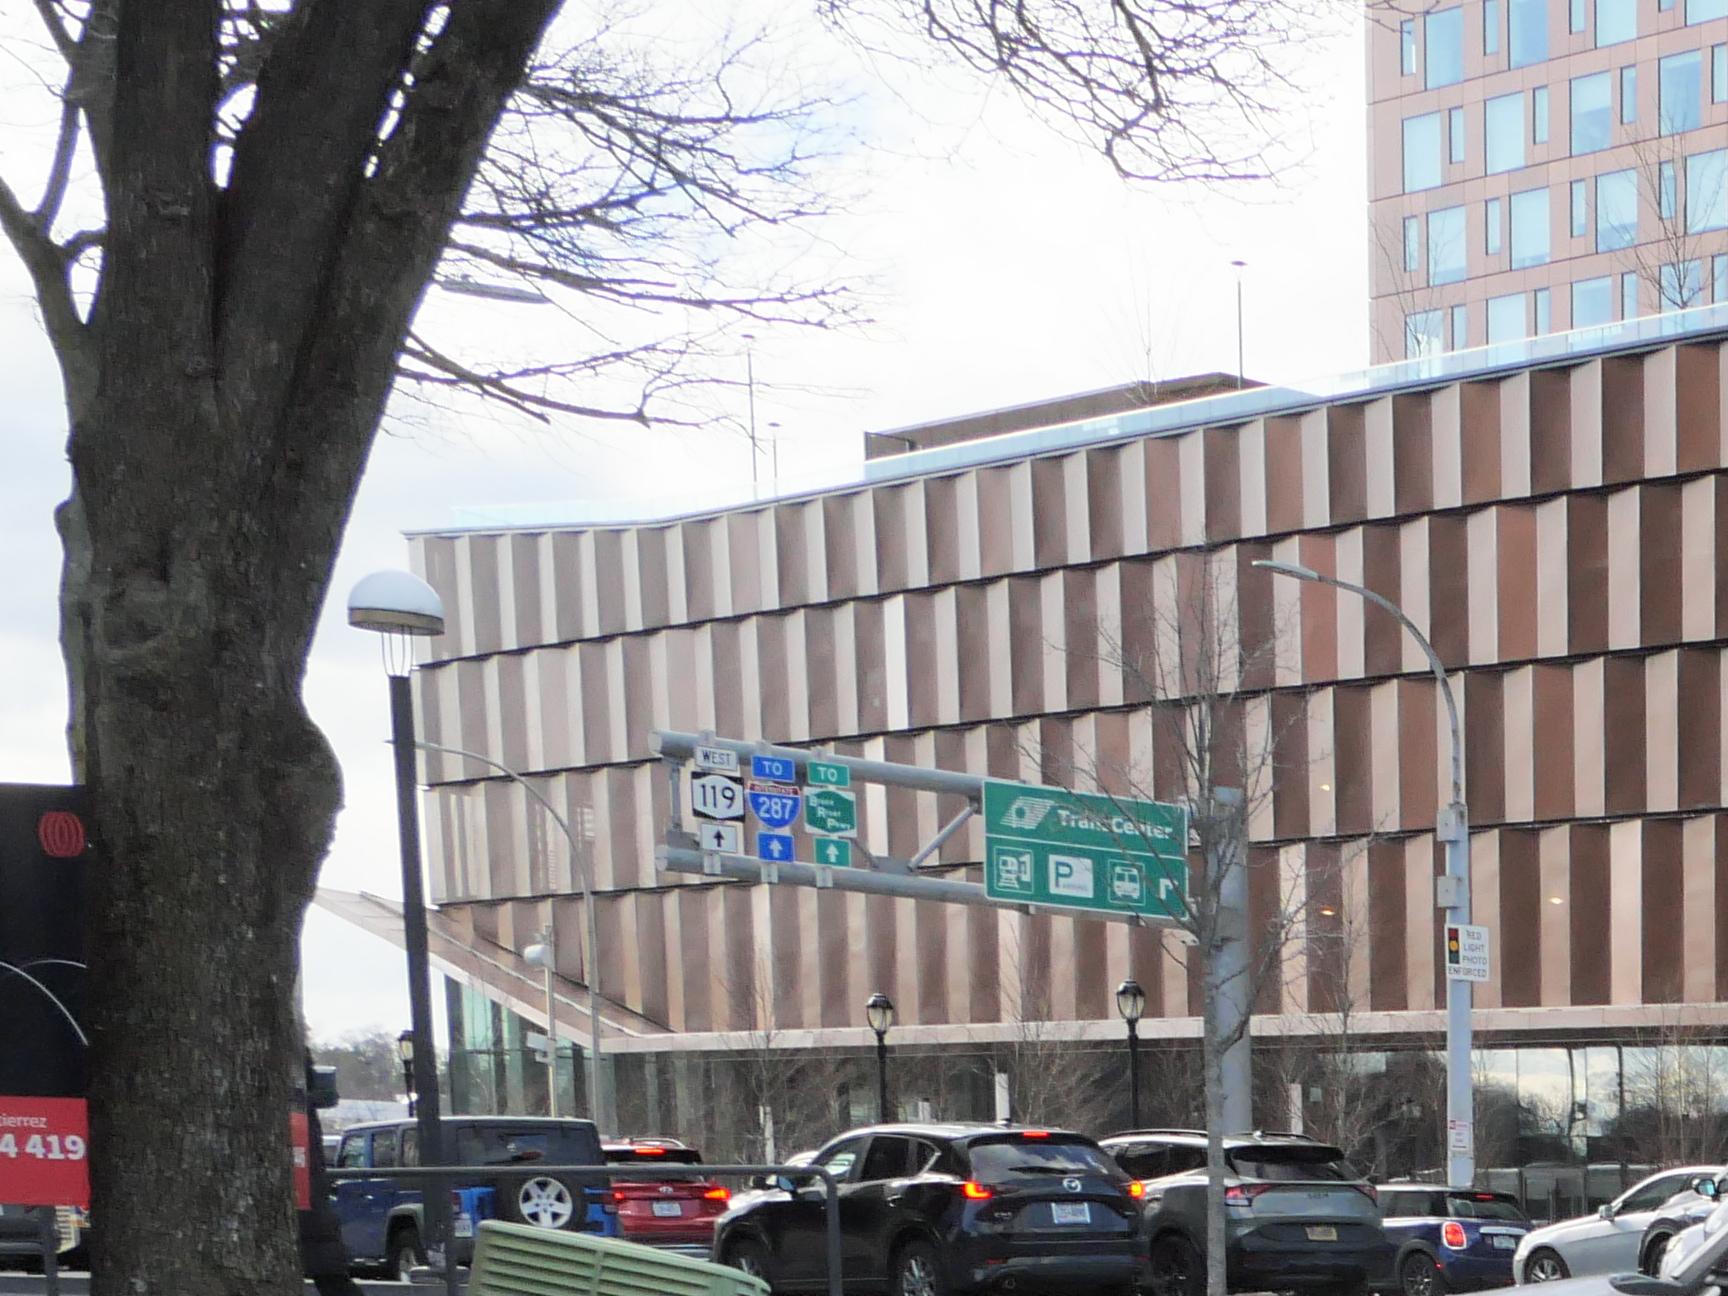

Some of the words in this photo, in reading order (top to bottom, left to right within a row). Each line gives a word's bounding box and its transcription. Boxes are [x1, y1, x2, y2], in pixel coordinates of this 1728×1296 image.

[702, 750, 732, 765] WEST
[762, 761, 783, 775] TO
[817, 766, 838, 782] TO
[701, 783, 736, 809] 119
[758, 797, 794, 820] 287
[25, 1134, 86, 1160] 419
